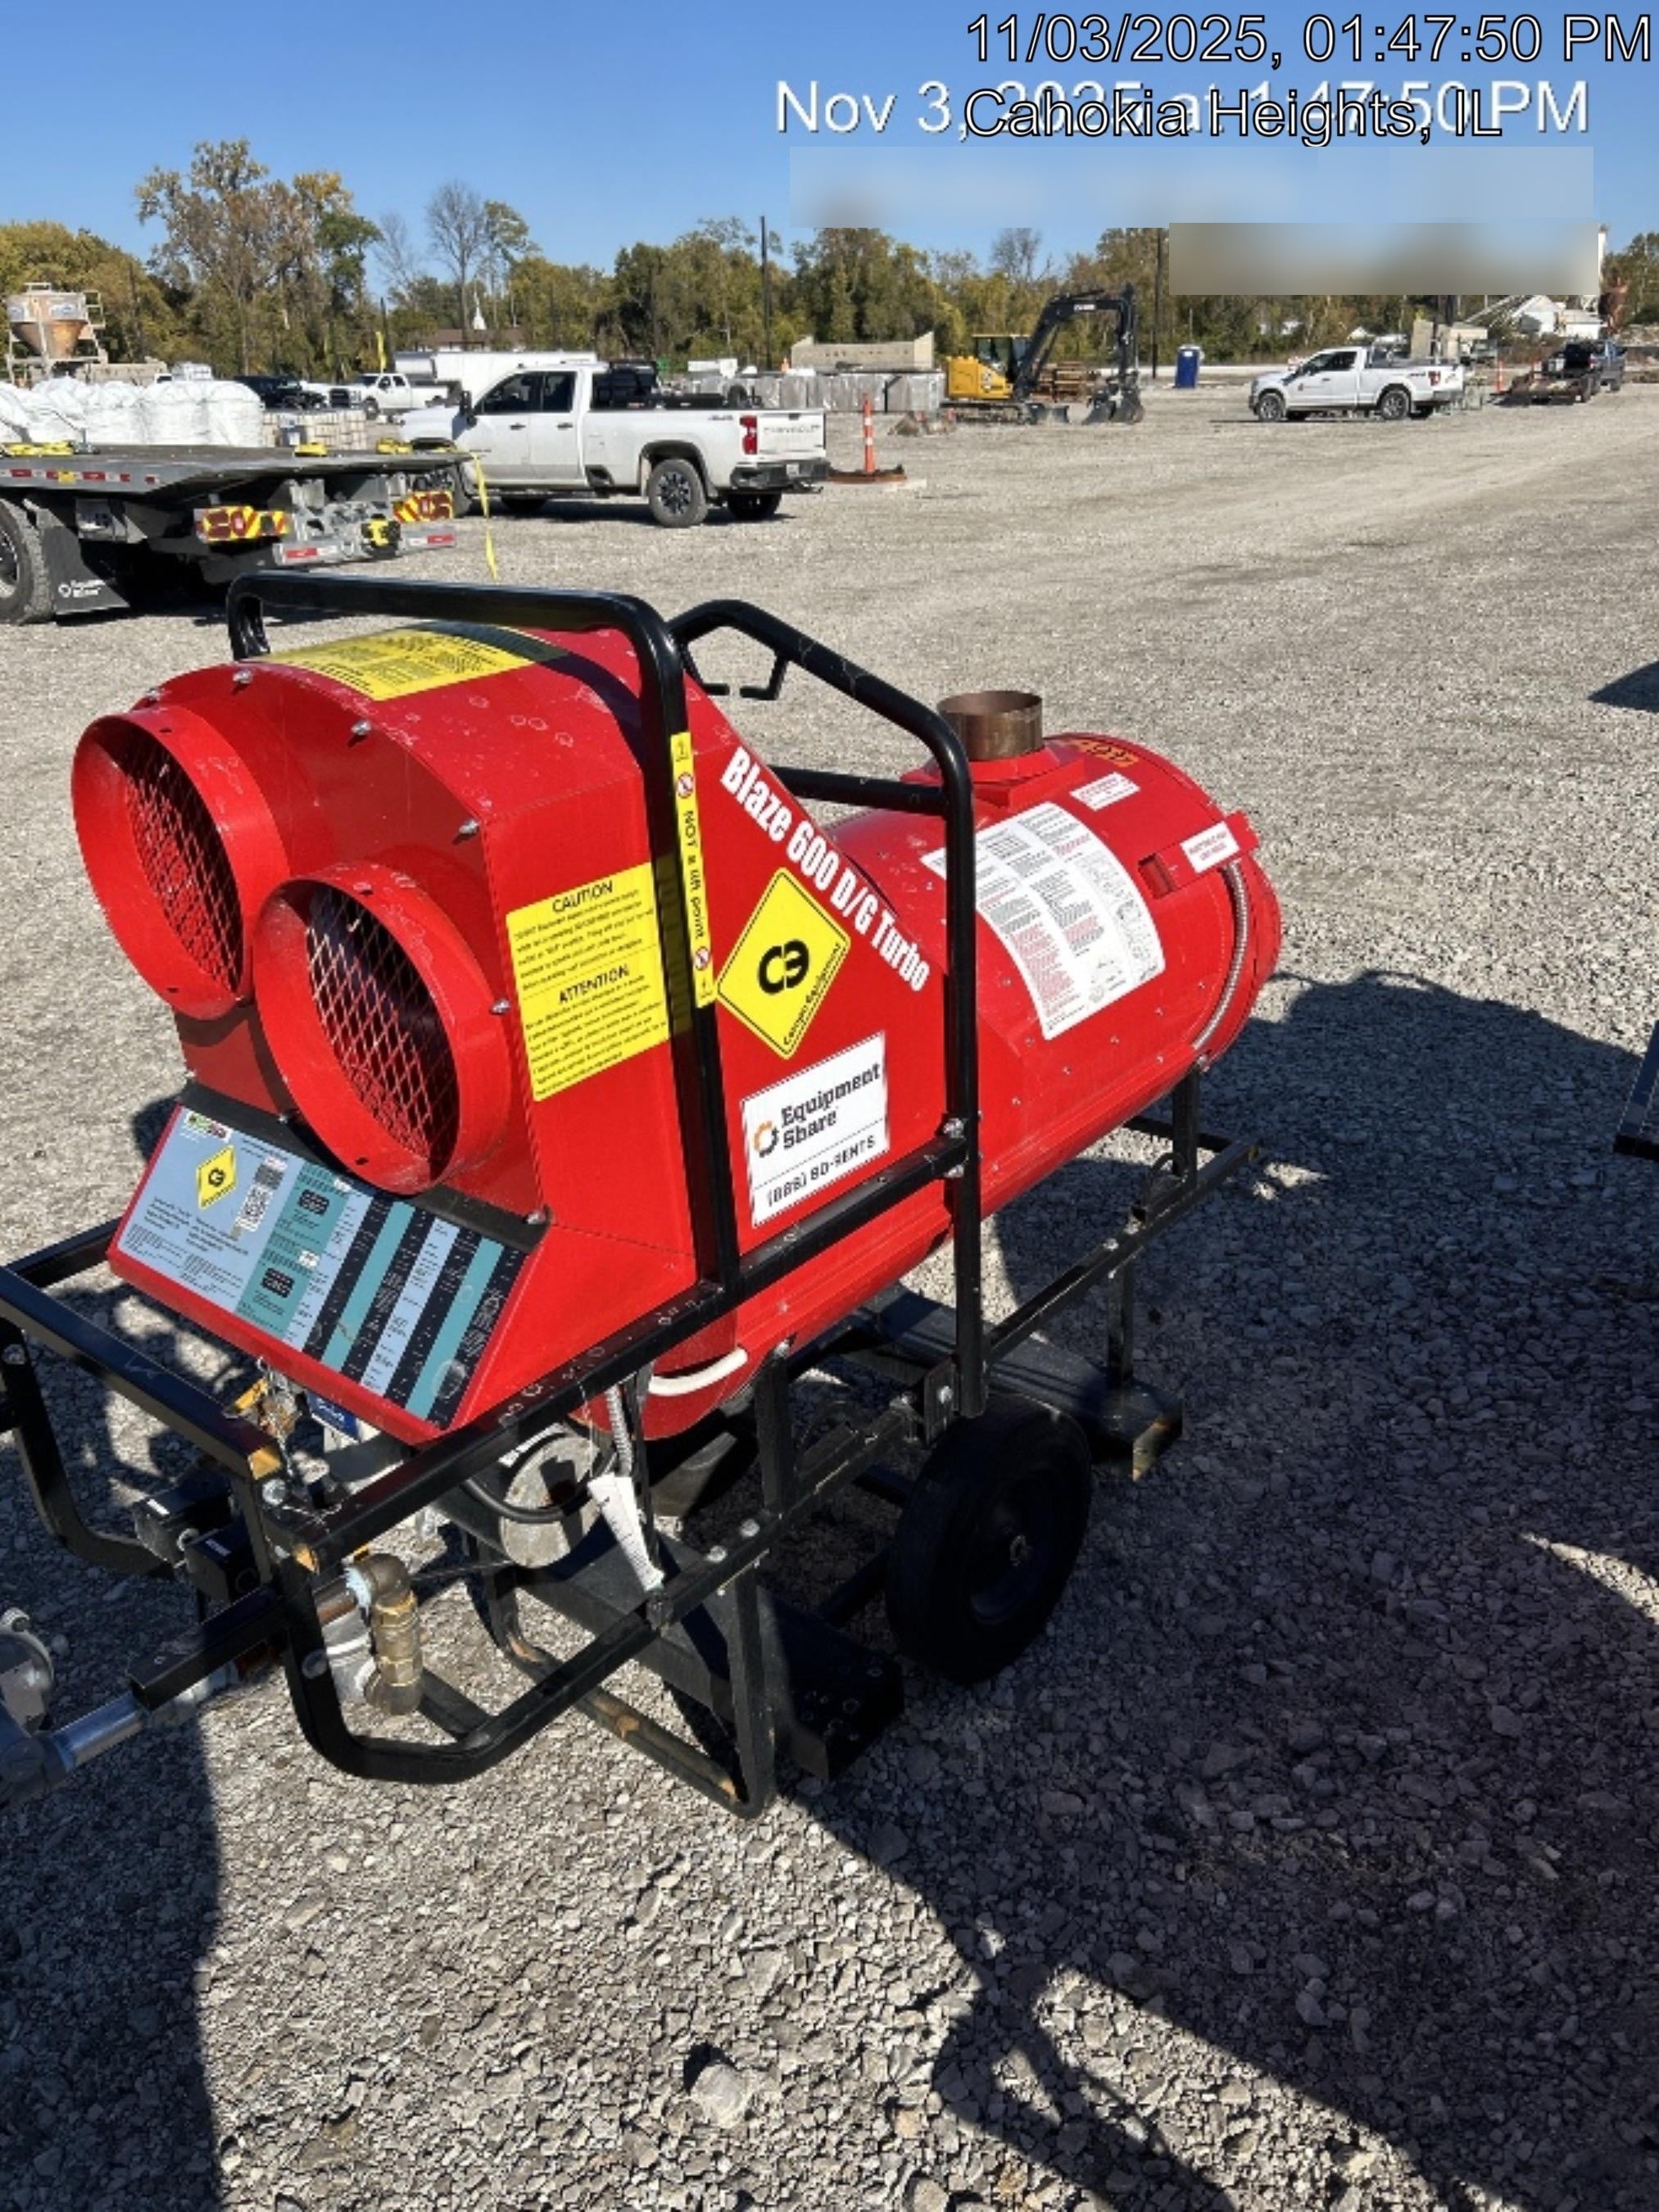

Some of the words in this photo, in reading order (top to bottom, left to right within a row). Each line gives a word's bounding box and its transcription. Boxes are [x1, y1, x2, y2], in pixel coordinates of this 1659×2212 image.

[682, 810, 696, 847] NOT
[720, 746, 793, 842] Blaze
[786, 820, 841, 891] 600
[830, 868, 879, 936] D/G
[871, 909, 931, 991] Turbo
[551, 880, 614, 913] CAUTION
[559, 963, 630, 1004] ATTENTION
[781, 1063, 882, 1128] Equipment
[783, 1109, 837, 1150] Share
